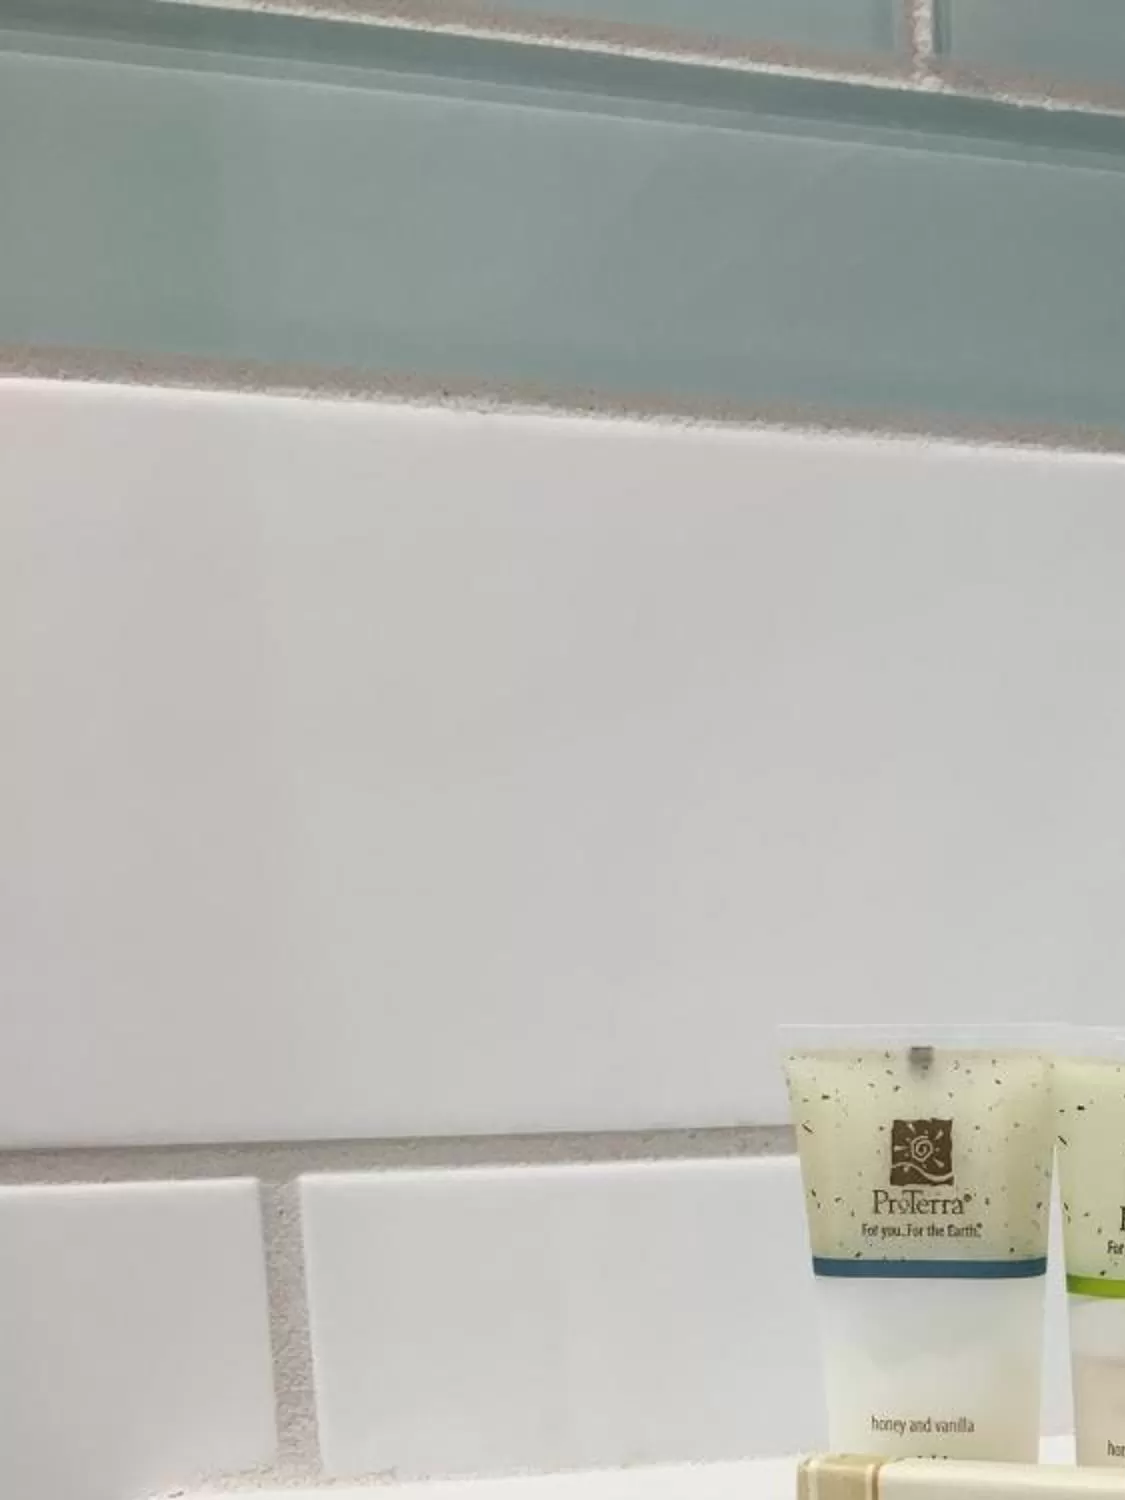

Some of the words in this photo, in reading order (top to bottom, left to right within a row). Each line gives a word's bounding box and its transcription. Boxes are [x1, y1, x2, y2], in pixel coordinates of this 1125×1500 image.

[861, 1223, 879, 1237] For
[906, 1223, 923, 1237] For
[927, 1223, 945, 1237] the
[1107, 1240, 1124, 1255] For
[871, 1414, 907, 1437] honey
[909, 1416, 932, 1433] and
[935, 1416, 975, 1433] vanilla
